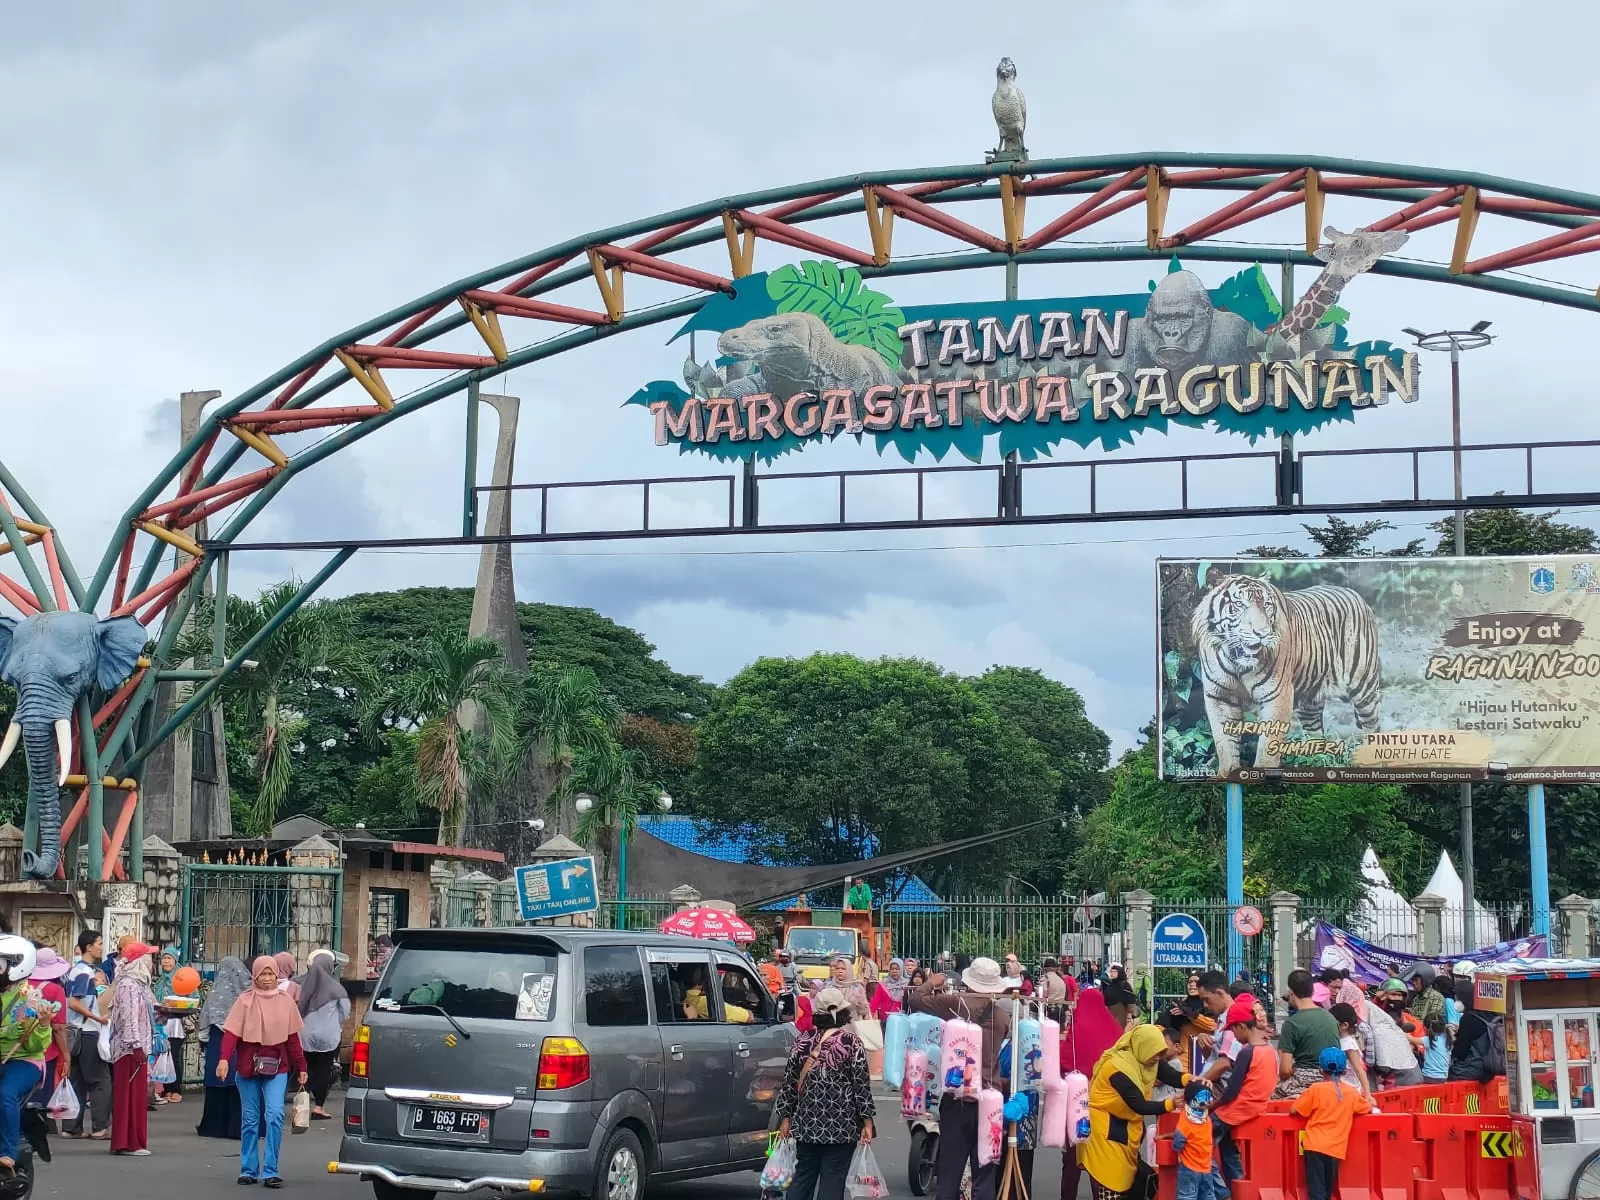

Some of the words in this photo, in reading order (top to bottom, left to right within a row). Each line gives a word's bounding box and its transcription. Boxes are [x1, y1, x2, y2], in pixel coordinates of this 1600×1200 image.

[898, 307, 1128, 367] TAMAN
[650, 376, 1080, 446] MARGASATWA
[1087, 351, 1419, 421] RAGUNAN
[1467, 621, 1530, 645] Enjoy
[1537, 621, 1561, 639] at
[1425, 649, 1600, 684] RAGUNANZOO
[1511, 700, 1577, 713] Hutanku
[1223, 720, 1290, 736] HARIMAU
[1456, 717, 1508, 730] Lestari
[1266, 737, 1345, 756] SUMATERA
[1368, 734, 1407, 745] PINTU
[1412, 734, 1456, 745] UTARA
[1374, 748, 1416, 759] NORTH
[1421, 747, 1452, 759] GATE
[1340, 770, 1369, 779] Taman
[1371, 770, 1429, 780] Margasatwa
[1431, 771, 1471, 780] Ragunan
[526, 903, 542, 912] TAXI
[547, 901, 563, 909] TAXI
[563, 897, 591, 906] ONLINE
[1154, 942, 1175, 951] PINTU
[1176, 942, 1204, 951] MASUK
[1156, 953, 1181, 963] UTARA
[416, 1108, 424, 1122] B
[432, 1110, 455, 1125] 1663
[460, 1112, 480, 1127] FFP
